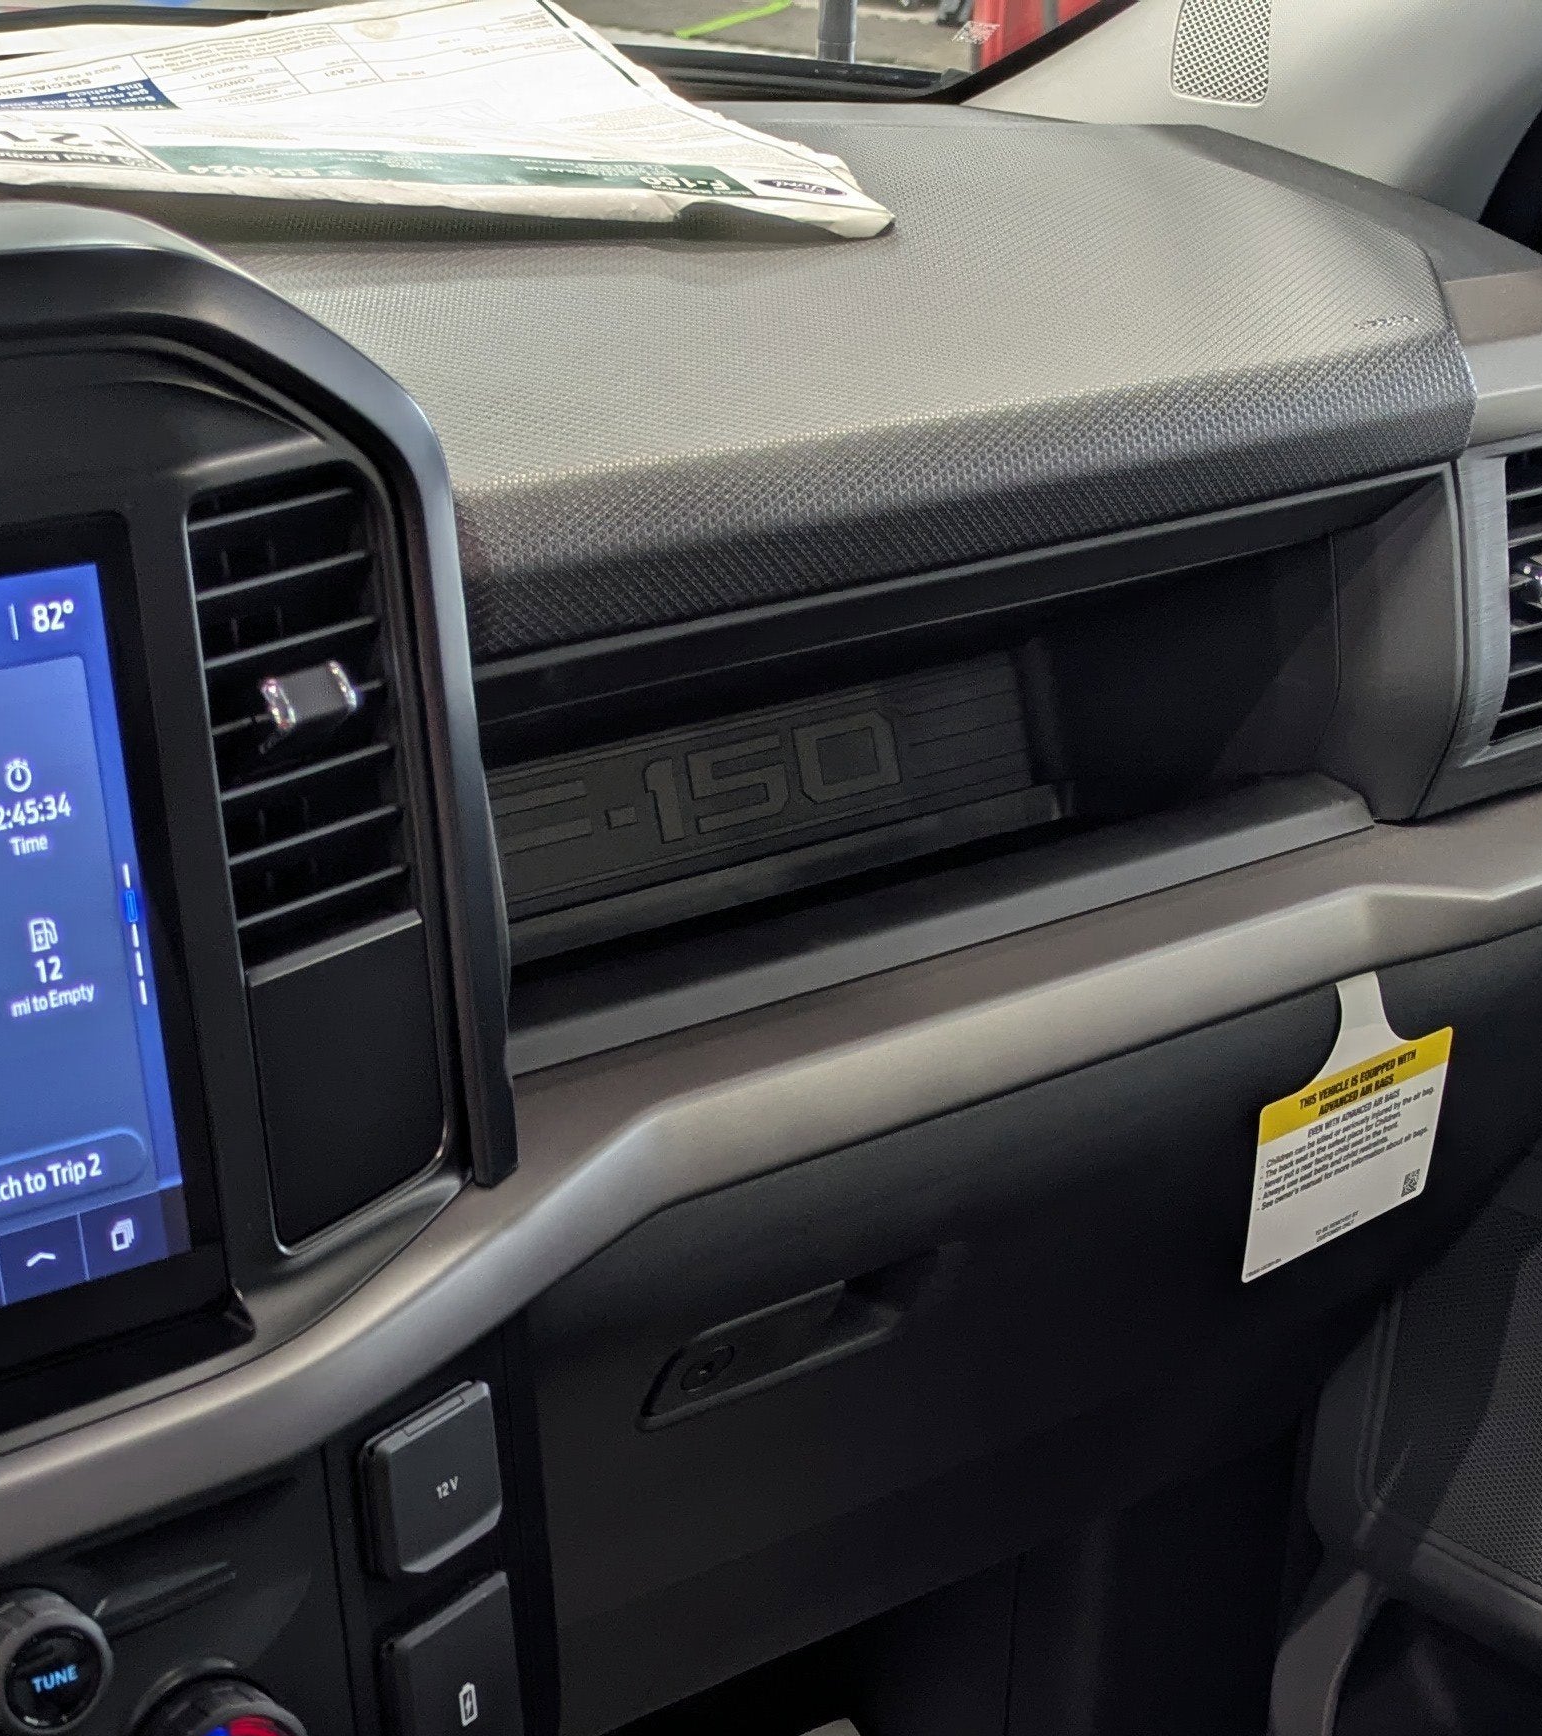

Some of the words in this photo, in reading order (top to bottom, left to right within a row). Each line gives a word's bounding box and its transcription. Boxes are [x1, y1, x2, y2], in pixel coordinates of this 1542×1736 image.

[25, 79, 93, 92] SPECIAL
[67, 88, 115, 98] vehicle
[117, 83, 144, 92] this
[127, 89, 150, 98] get
[207, 77, 256, 91] CONVOY
[64, 154, 112, 163] Fuel
[640, 177, 731, 191] F-150
[32, 600, 74, 633] 82°
[10, 834, 48, 856] Time
[34, 956, 64, 984] 12
[10, 998, 31, 1018] mi
[31, 996, 47, 1014] to
[47, 980, 95, 1009] Empty
[1299, 1092, 1317, 1109] THIS
[1318, 1078, 1349, 1100] VEHICLE
[1350, 1074, 1359, 1086] IS
[1359, 1058, 1396, 1082] EQUIPPED
[1396, 1049, 1416, 1065] WITH
[1318, 1089, 1358, 1115] ADVANCED
[1359, 1083, 1373, 1096] AIR
[1373, 1073, 1394, 1090] BAGS
[22, 1171, 47, 1196] to
[47, 1160, 87, 1189] Trip
[87, 1152, 104, 1178] 2
[31, 1663, 79, 1693] TUNE
